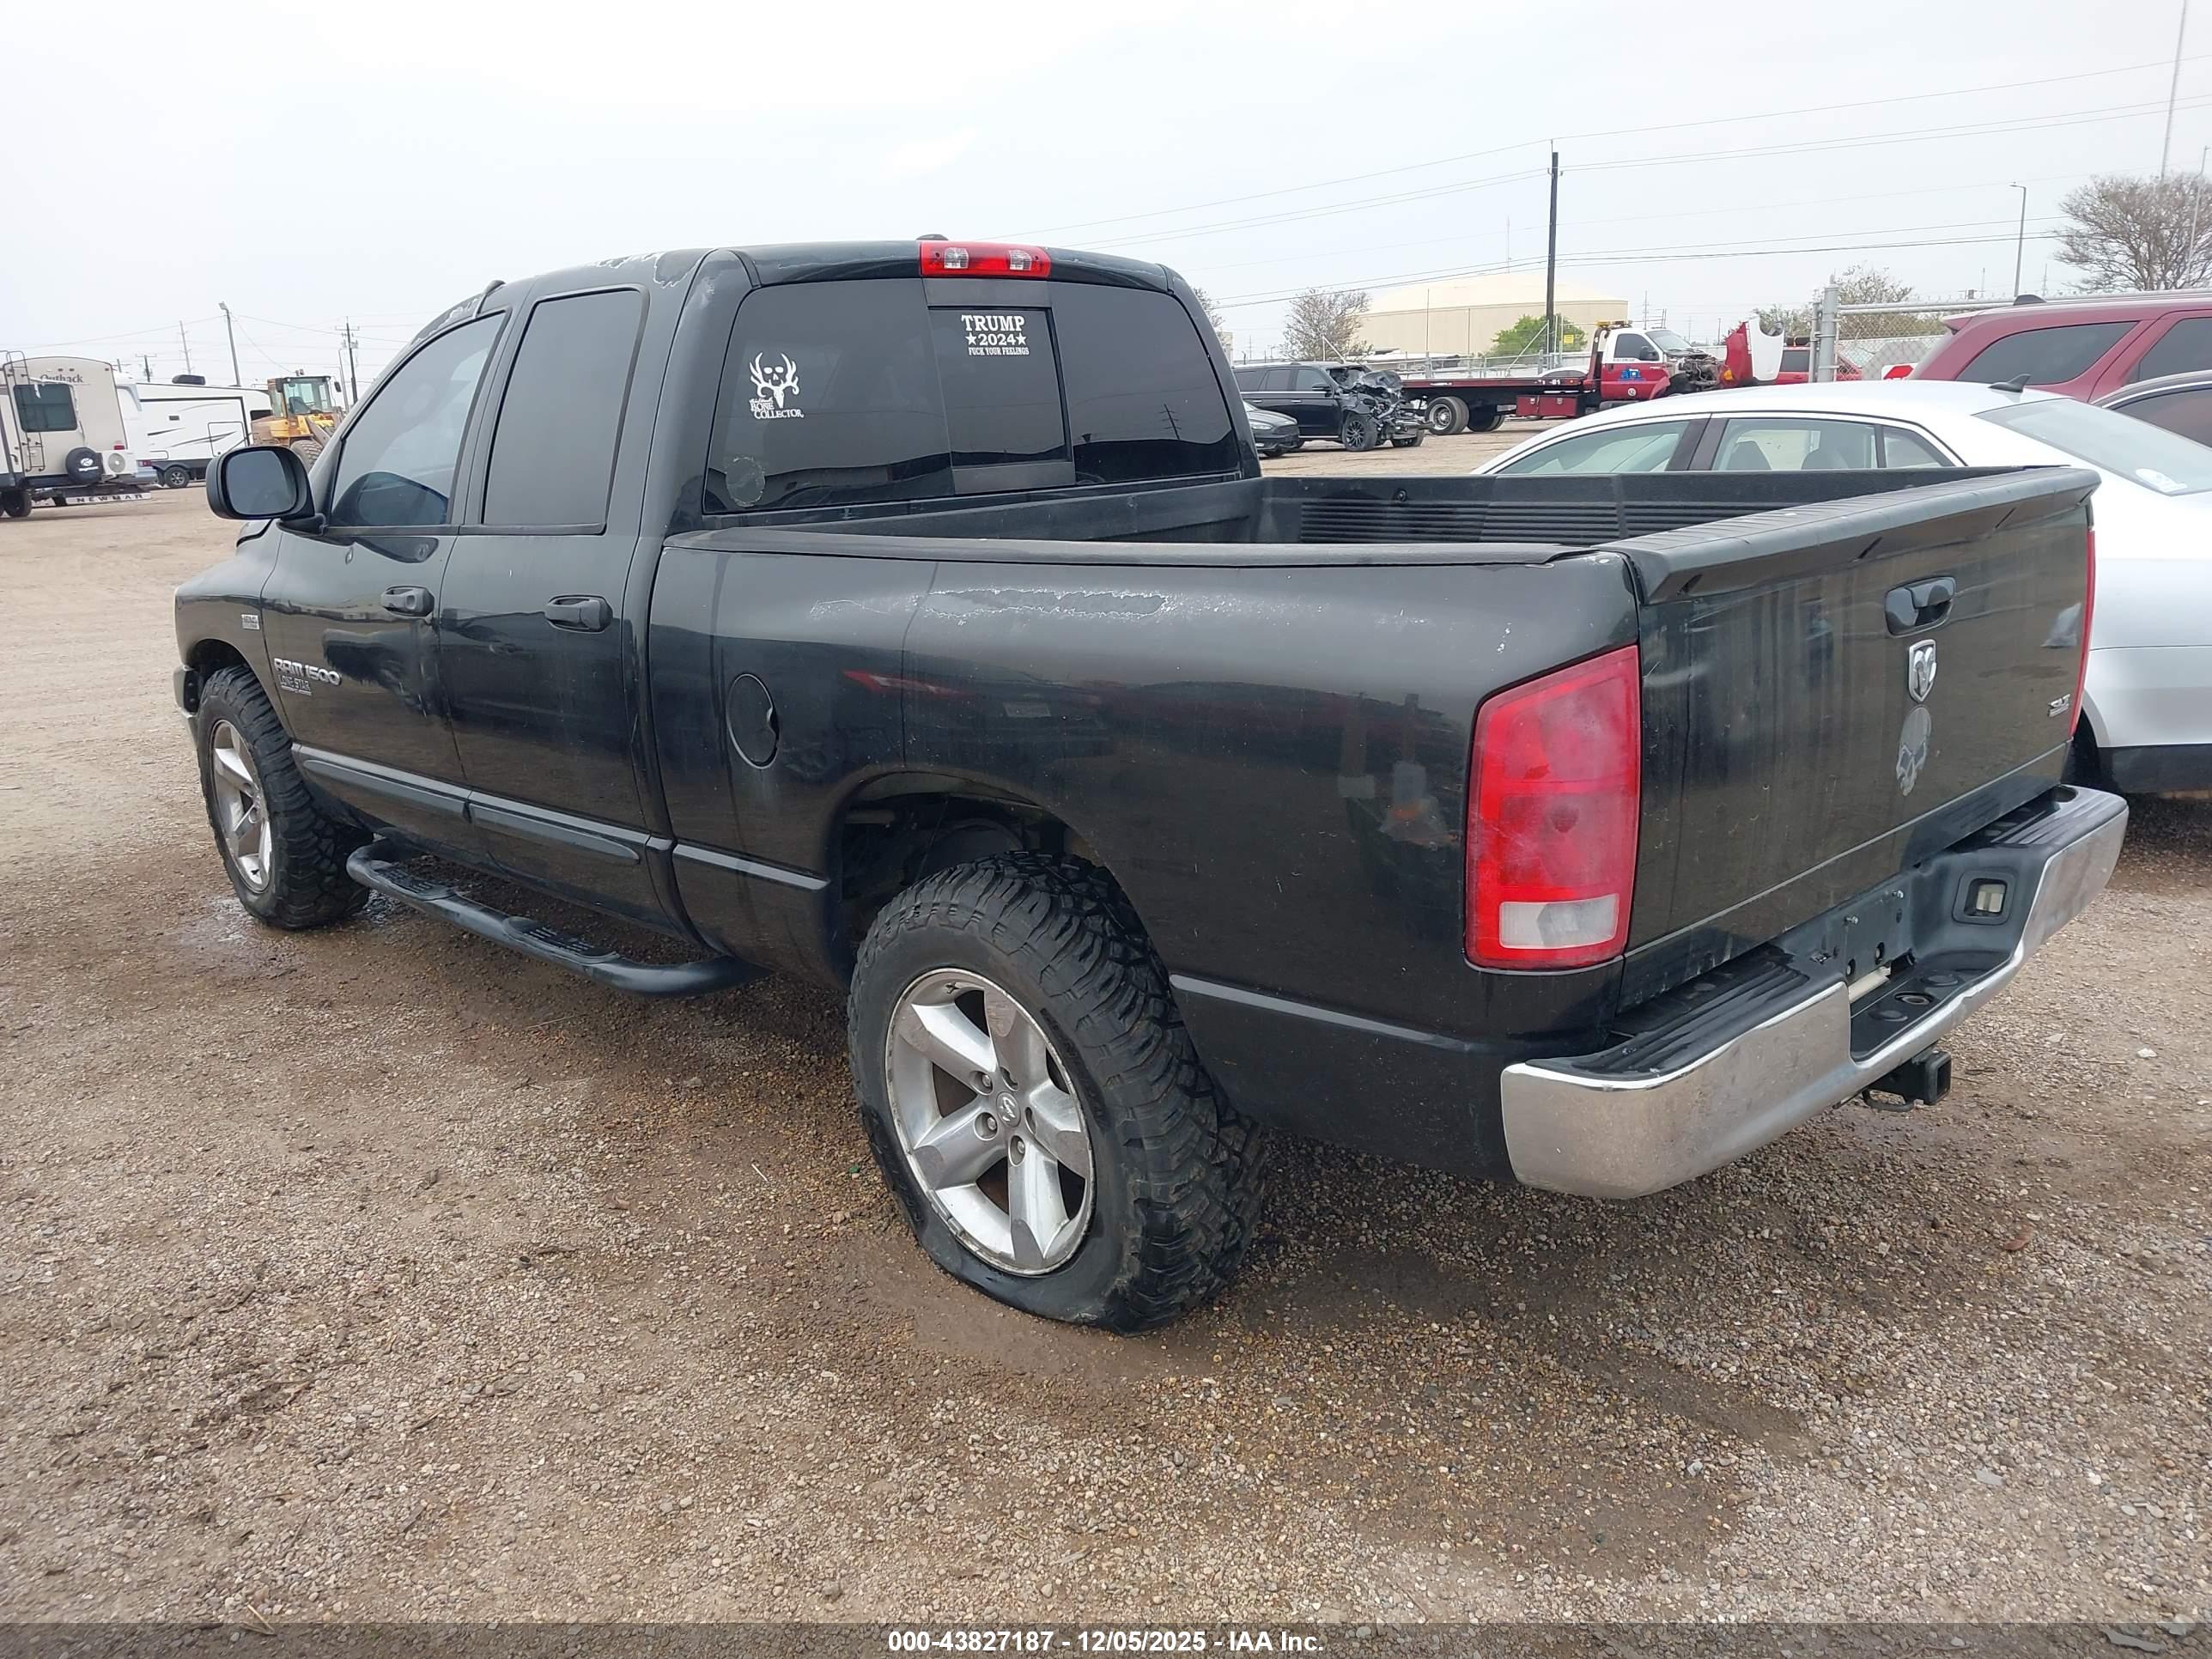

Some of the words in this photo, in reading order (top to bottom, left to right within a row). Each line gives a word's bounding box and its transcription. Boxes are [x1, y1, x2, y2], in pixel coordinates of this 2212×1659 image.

[961, 314, 1025, 331] TRUMP
[978, 333, 1017, 346] 2024
[968, 347, 985, 356] FUCK
[985, 347, 1002, 356] YOUR
[1001, 347, 1030, 356] FEELINGS
[750, 402, 775, 411] BONE
[754, 409, 805, 419] COLLECTOR
[76, 494, 143, 502] NEWMAR
[274, 658, 304, 678] RAM
[304, 665, 341, 686] 1500
